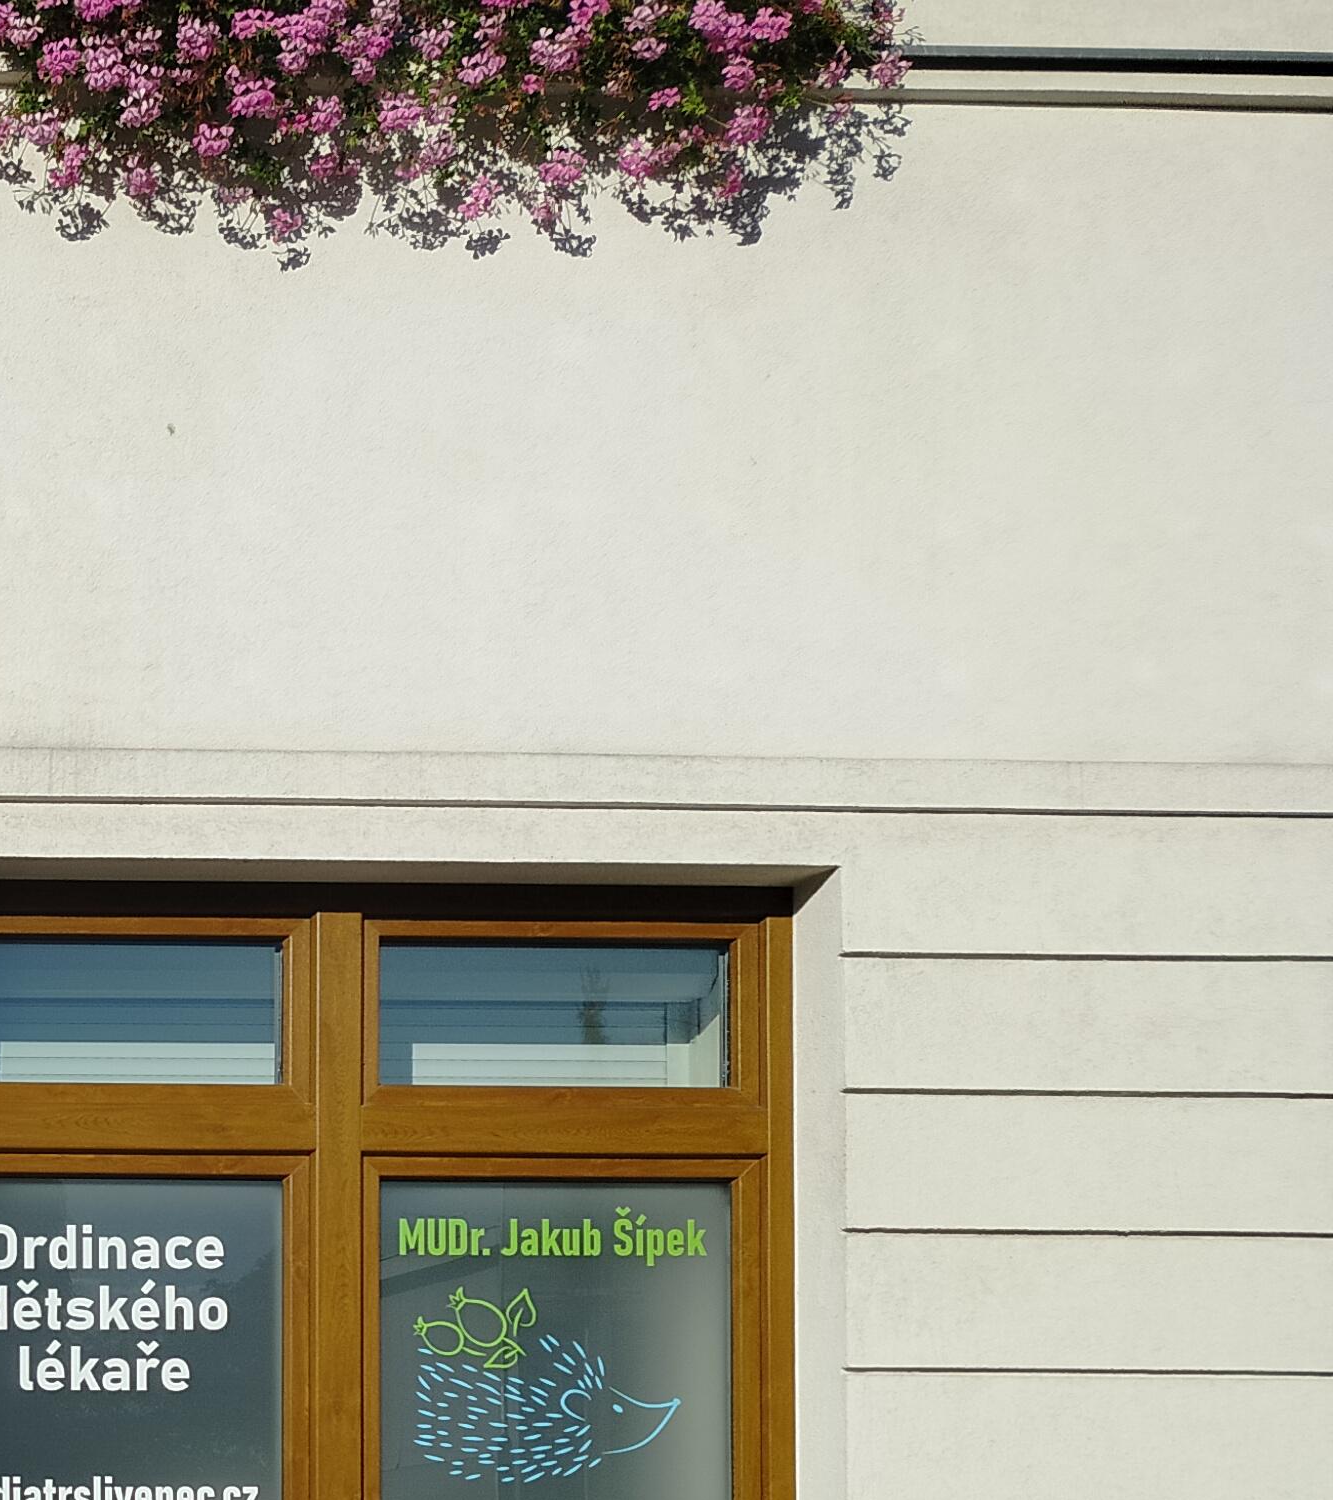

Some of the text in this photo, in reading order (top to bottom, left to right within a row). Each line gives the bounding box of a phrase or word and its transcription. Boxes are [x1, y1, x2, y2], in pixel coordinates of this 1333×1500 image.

[398, 1206, 708, 1267] MUDr. Jakub Šípek
[18, 1339, 191, 1392] lékaře
